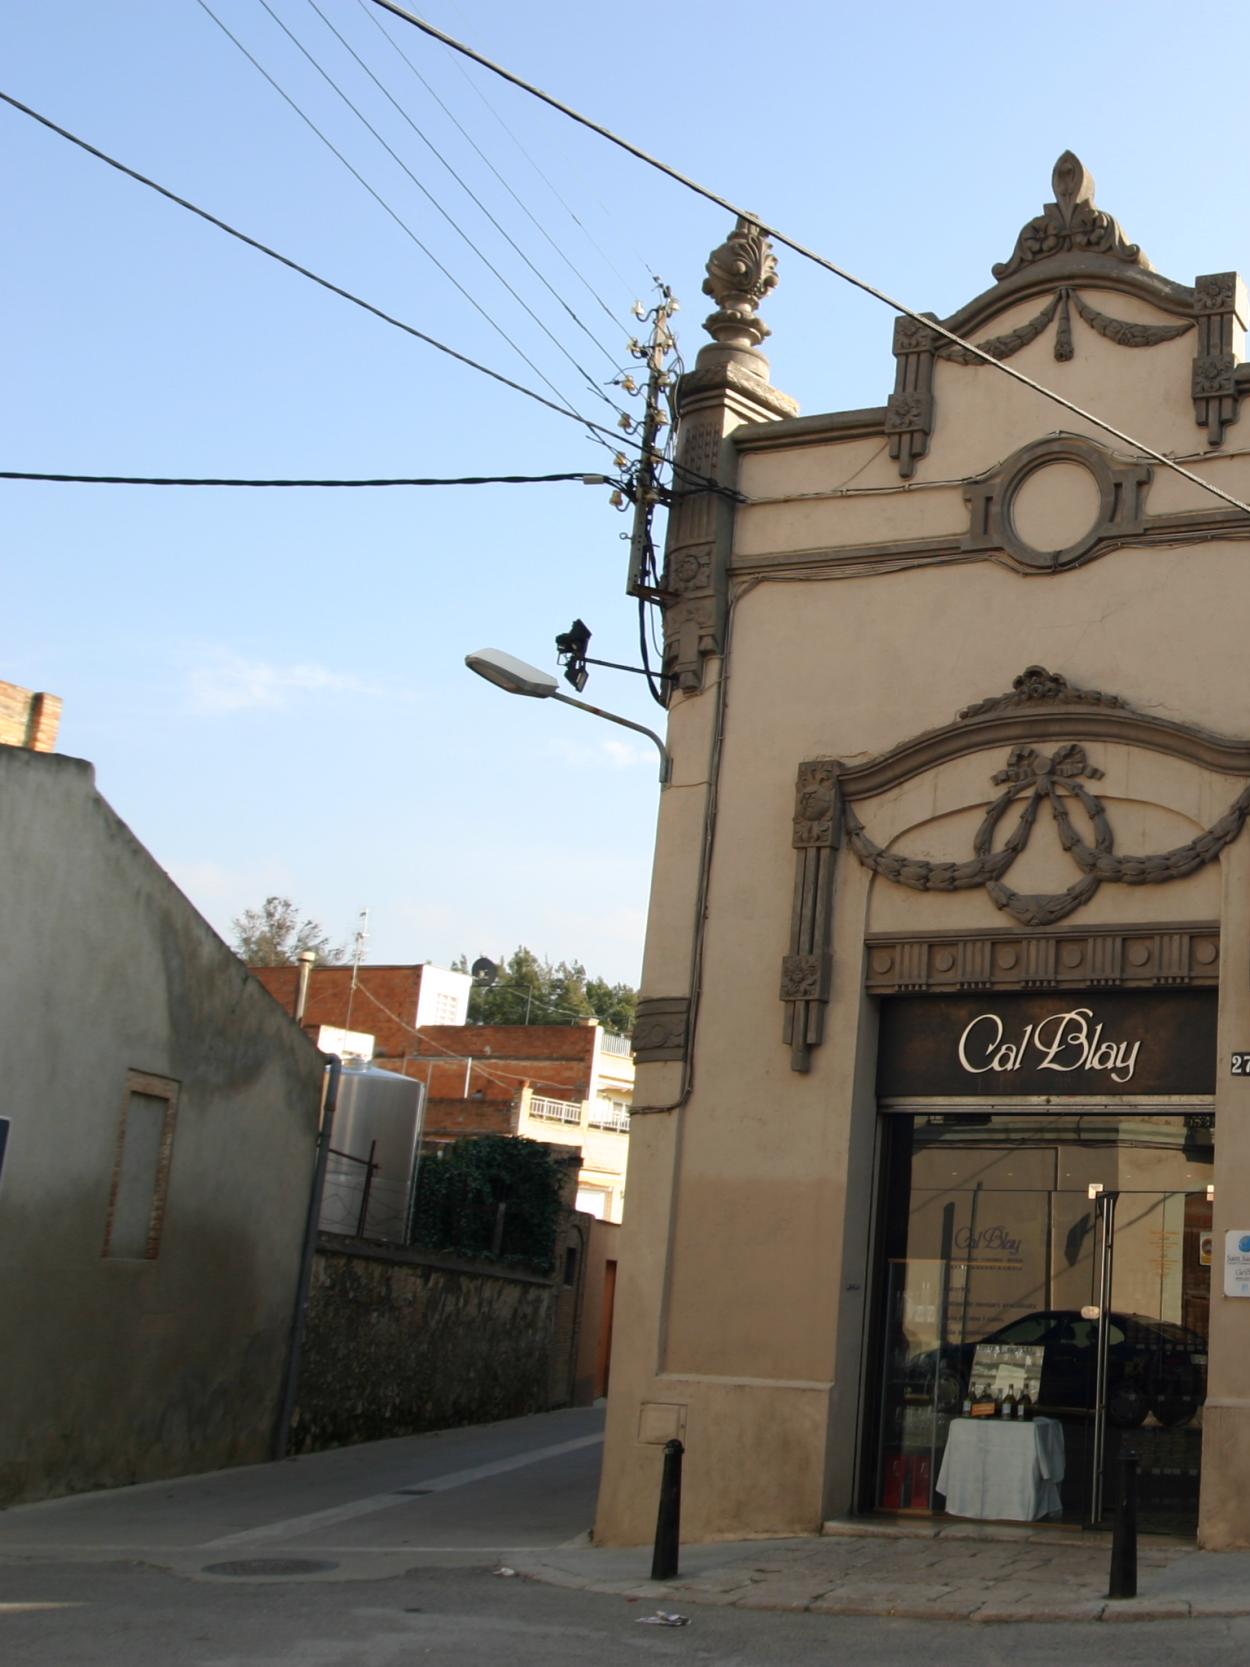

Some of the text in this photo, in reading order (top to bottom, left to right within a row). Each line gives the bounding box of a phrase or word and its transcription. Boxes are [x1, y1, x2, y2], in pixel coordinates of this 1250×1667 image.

[958, 1008, 1141, 1083] Cal Blay
[983, 1225, 1022, 1255] Blay
